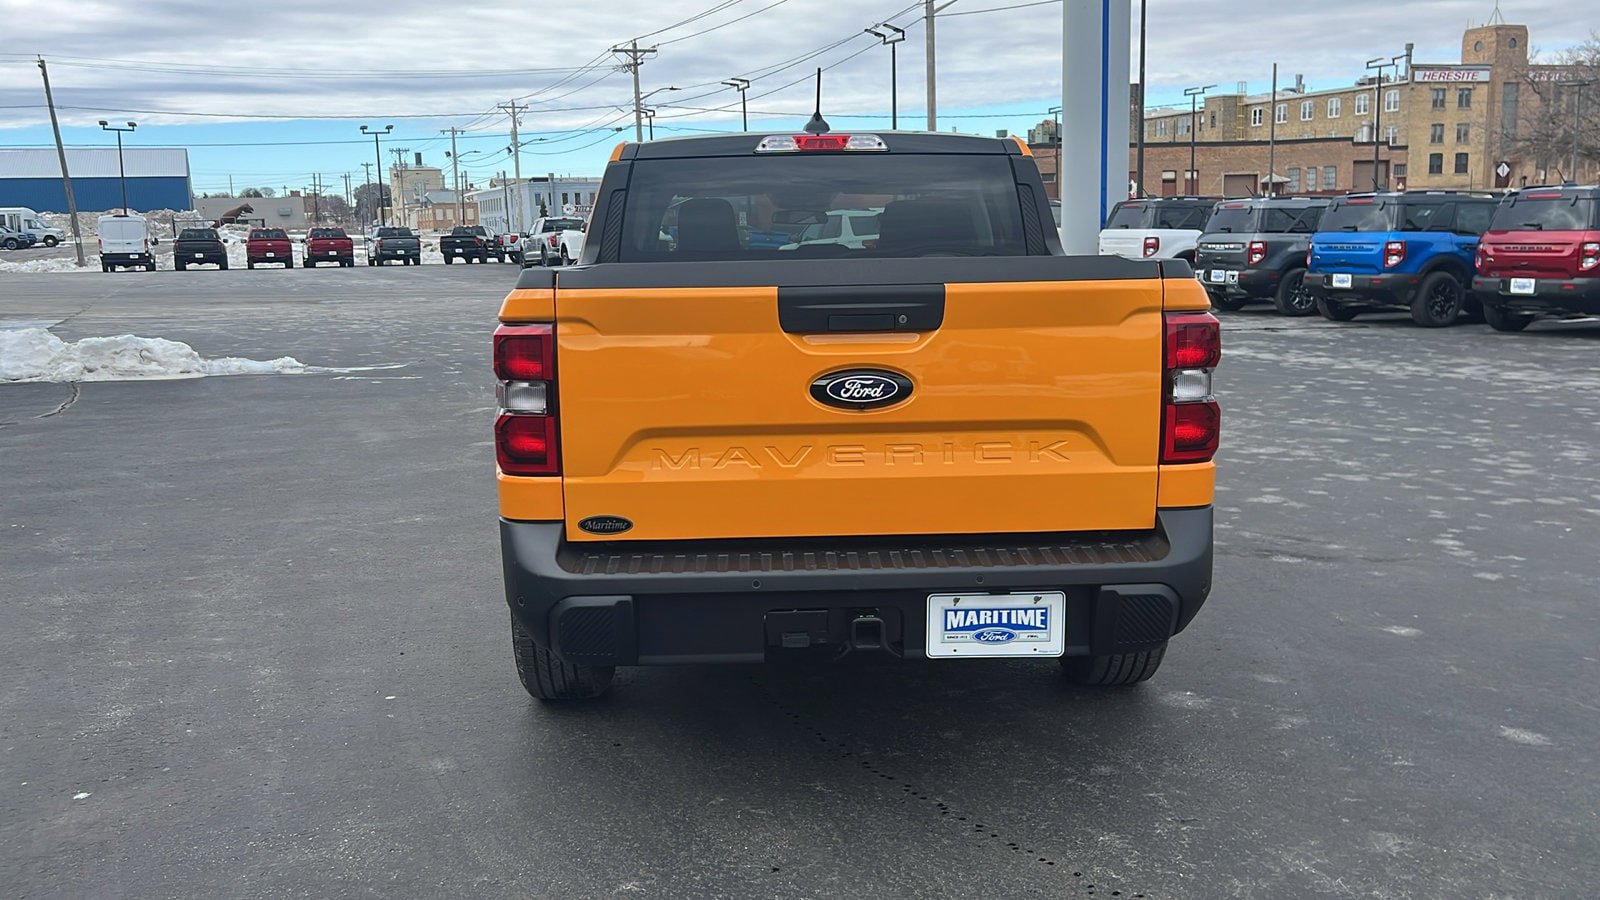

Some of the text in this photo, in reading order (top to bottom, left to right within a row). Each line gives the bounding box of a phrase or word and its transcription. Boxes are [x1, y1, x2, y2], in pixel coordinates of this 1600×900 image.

[1422, 71, 1480, 81] HERESITE
[840, 379, 885, 398] Ford
[651, 440, 1072, 471] MAVERICK
[585, 520, 628, 530] Maritime
[946, 609, 1046, 630] MARITIME
[980, 631, 1009, 641] Ford
